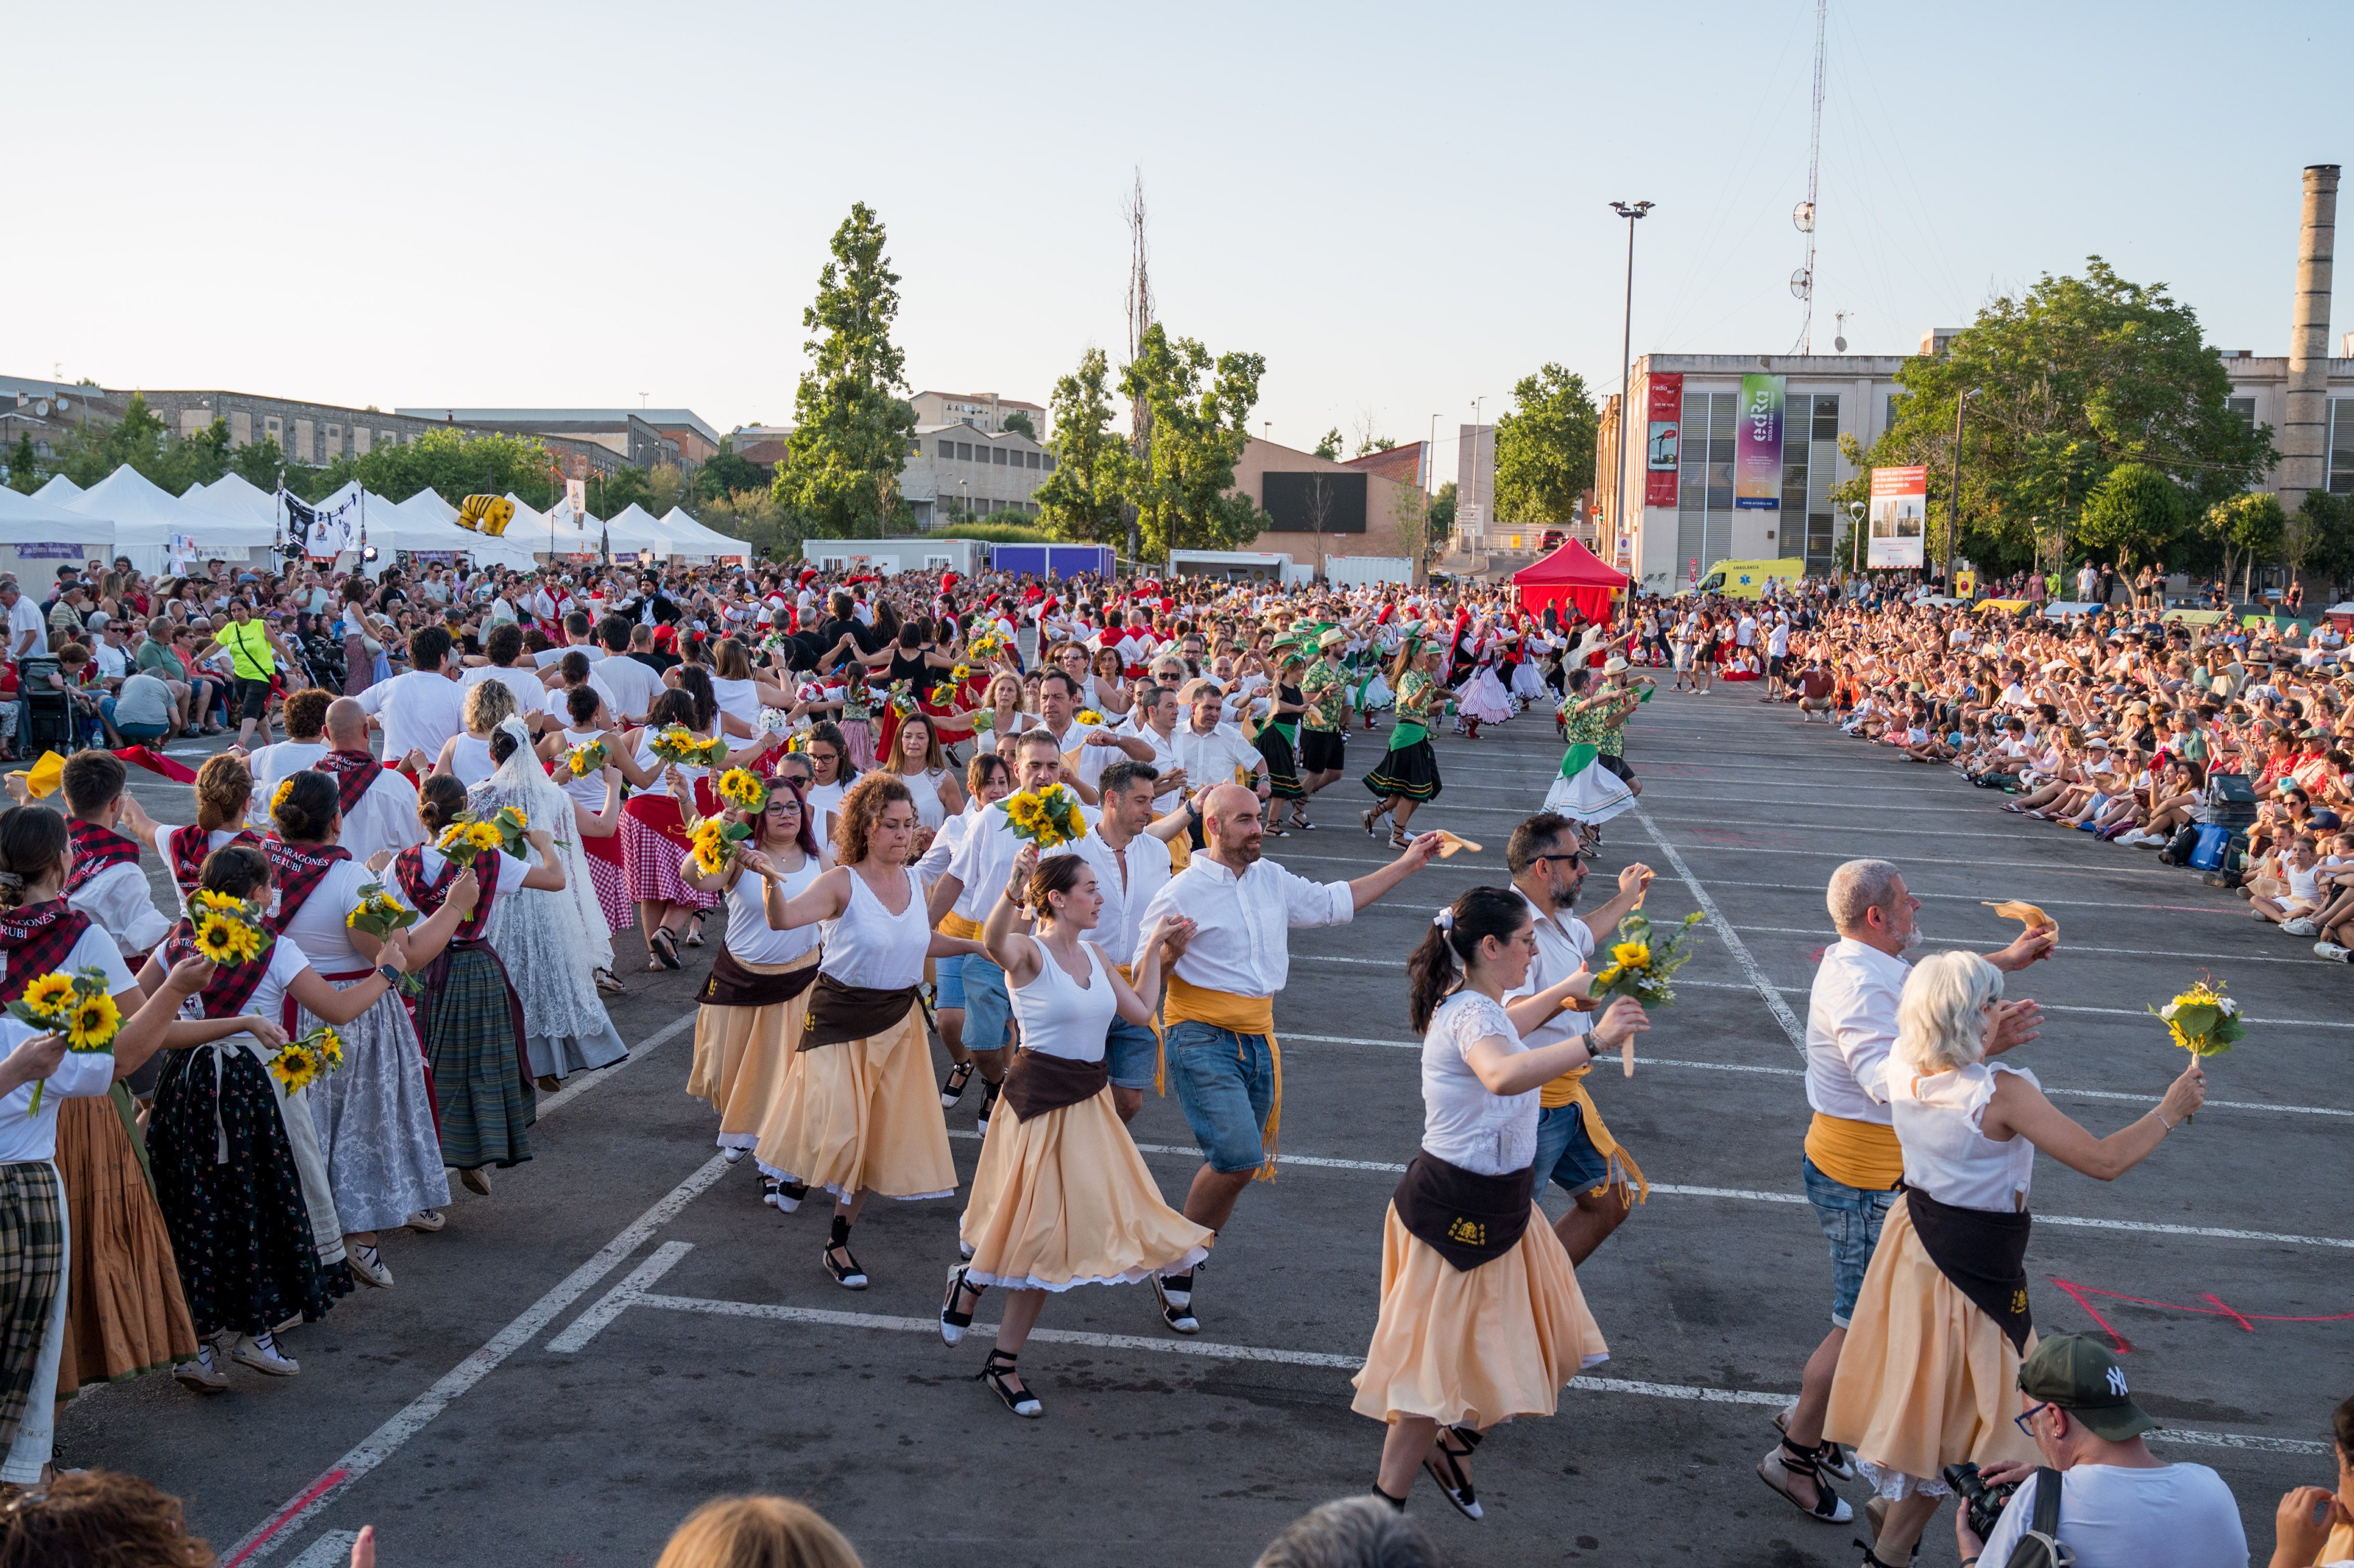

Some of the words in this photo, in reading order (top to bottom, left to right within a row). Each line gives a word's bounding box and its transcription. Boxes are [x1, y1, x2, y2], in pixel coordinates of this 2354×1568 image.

[271, 854, 282, 864] DE
[281, 857, 302, 872] RUBÍ
[282, 846, 329, 866] ARAGONÉS
[3, 911, 56, 927] AGONÉS
[1, 924, 28, 939] RUBÍ
[169, 937, 195, 949] CENTRO
[2106, 1366, 2128, 1396] NY
